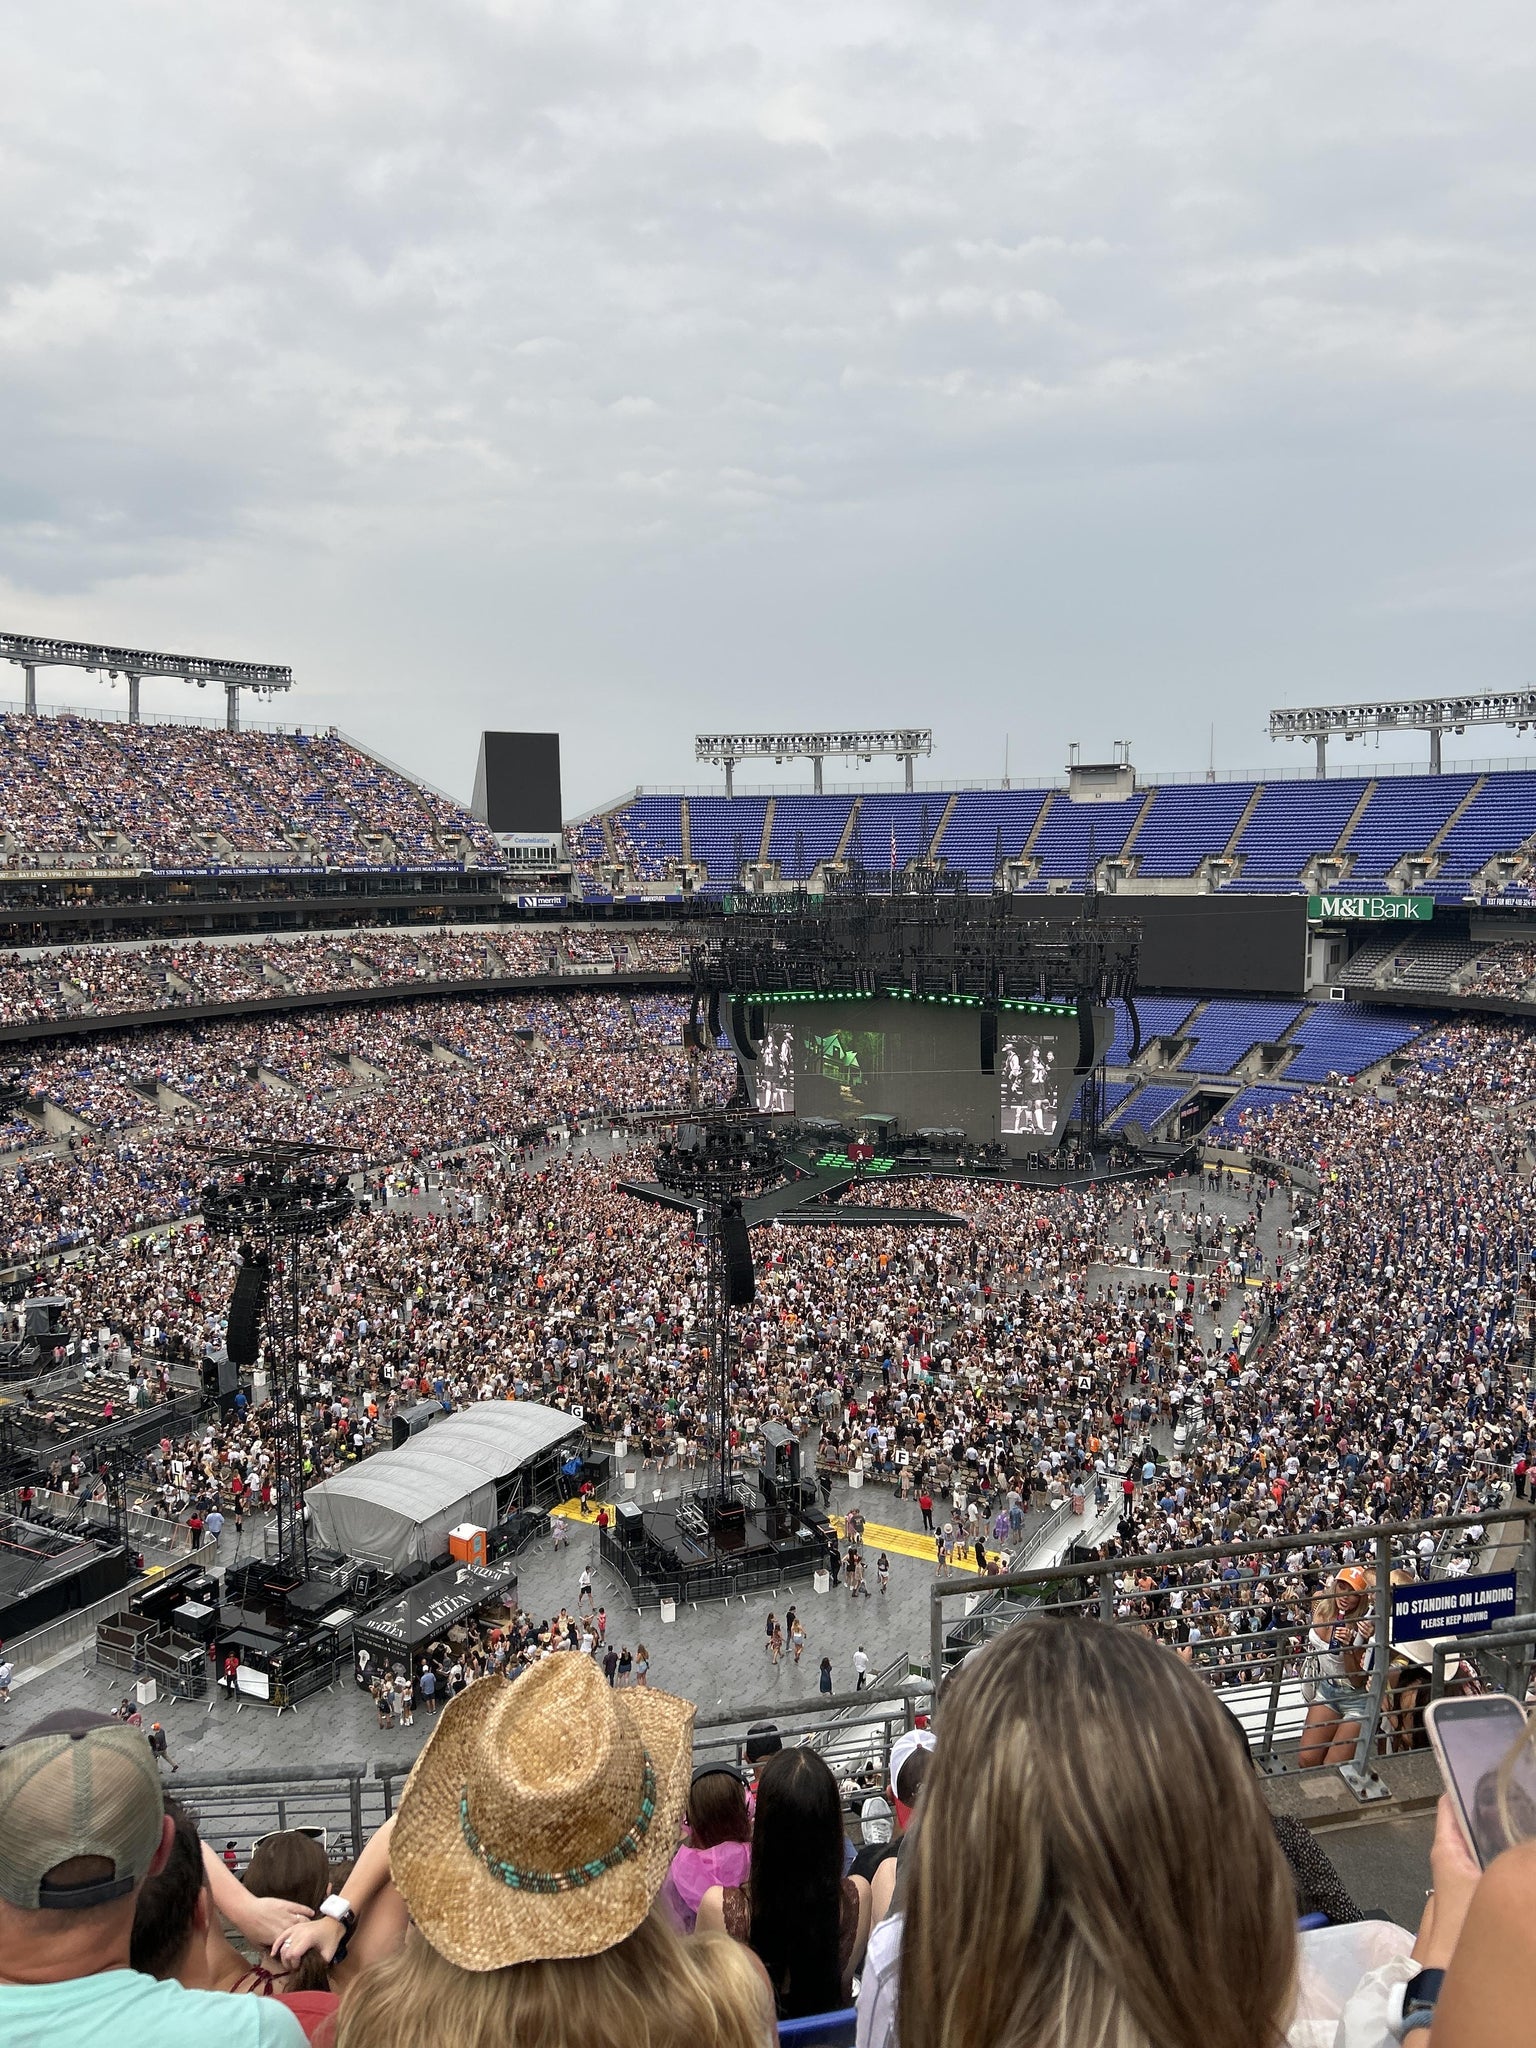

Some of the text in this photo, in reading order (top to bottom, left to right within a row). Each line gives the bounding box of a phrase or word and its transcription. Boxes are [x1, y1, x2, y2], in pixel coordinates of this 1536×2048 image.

[1320, 897, 1420, 918] M&T Bank
[385, 1368, 393, 1377] H
[1080, 1379, 1089, 1388] A
[573, 1407, 581, 1417] G
[899, 1452, 906, 1463] F
[174, 1463, 180, 1474] L
[1349, 1567, 1361, 1579] T
[1396, 1587, 1514, 1616] NO STANDING ON LANDING
[416, 1594, 471, 1627] WALLEN
[1421, 1611, 1489, 1629] PLEASE KEEP MOVING
[366, 1620, 407, 1638] WALLEN
